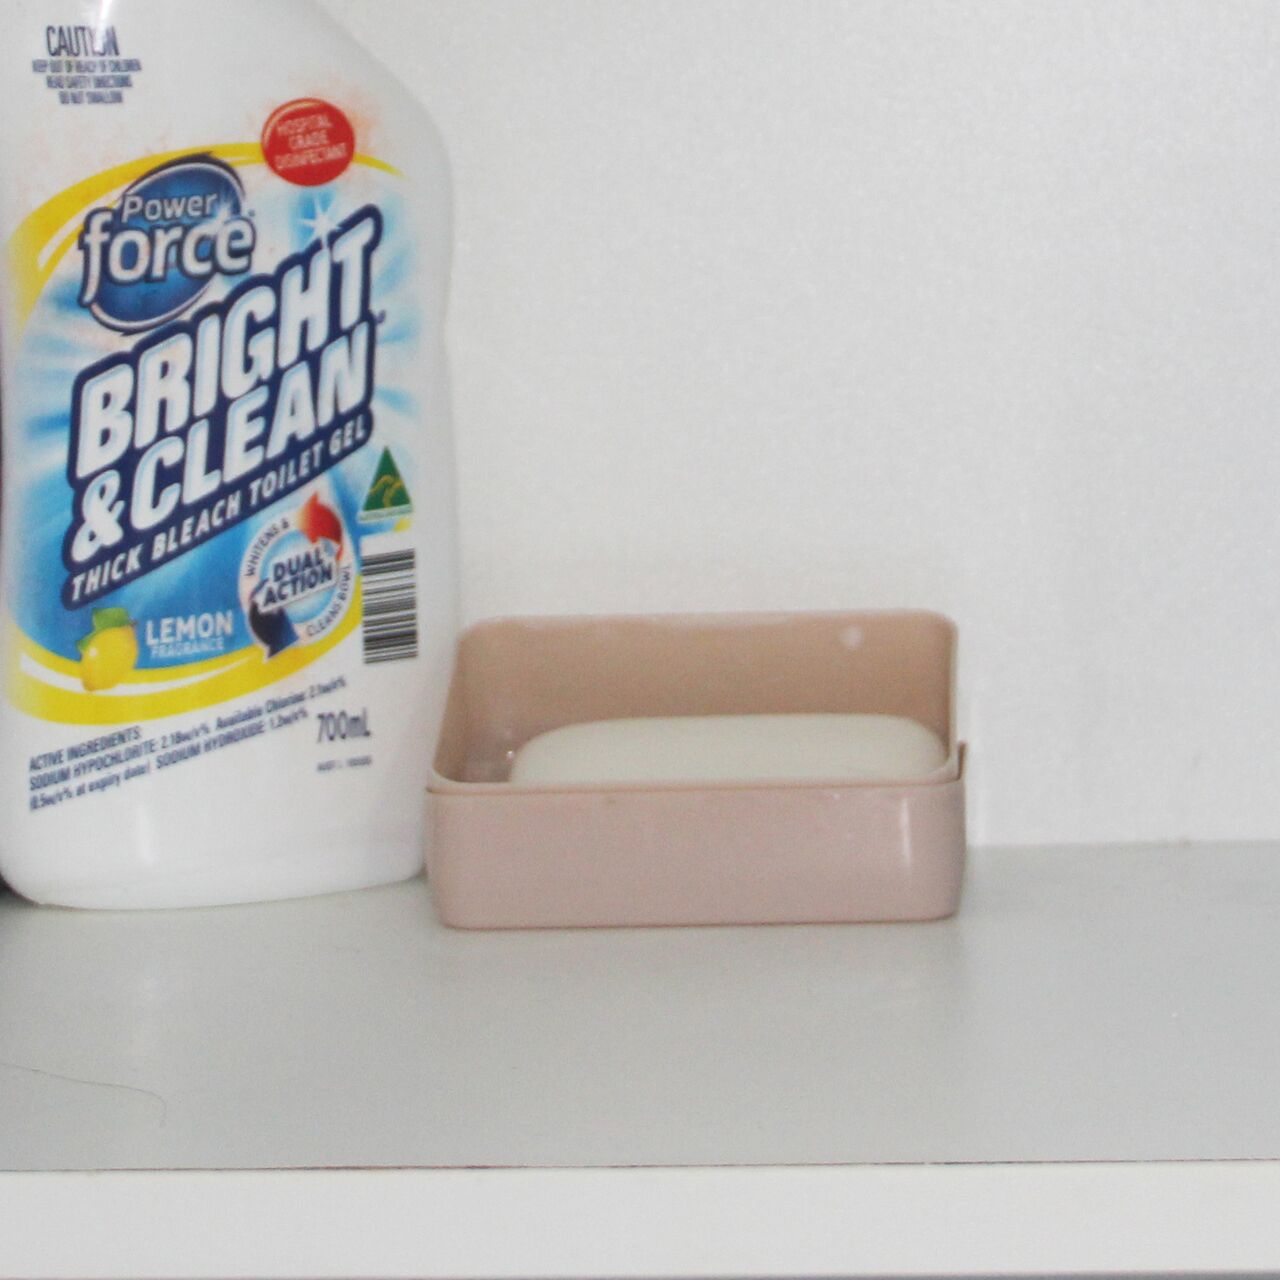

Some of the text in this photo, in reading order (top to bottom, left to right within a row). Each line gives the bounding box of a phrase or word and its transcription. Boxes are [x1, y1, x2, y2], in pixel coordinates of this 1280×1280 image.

[122, 192, 218, 221] Power
[80, 211, 253, 304] force
[75, 215, 374, 480] BRIGHT
[71, 543, 143, 602] THICK
[151, 489, 242, 562] BLEACH
[250, 441, 323, 506] TOILET
[329, 415, 366, 456] GEL
[244, 522, 284, 577] WHITENS
[273, 545, 324, 583] DUAL
[263, 563, 333, 607] ACTION
[145, 610, 234, 647] LEMON
[151, 637, 225, 659] FRAGRANCE
[317, 706, 372, 744] 700mL
[30, 749, 64, 771] ACTIVE
